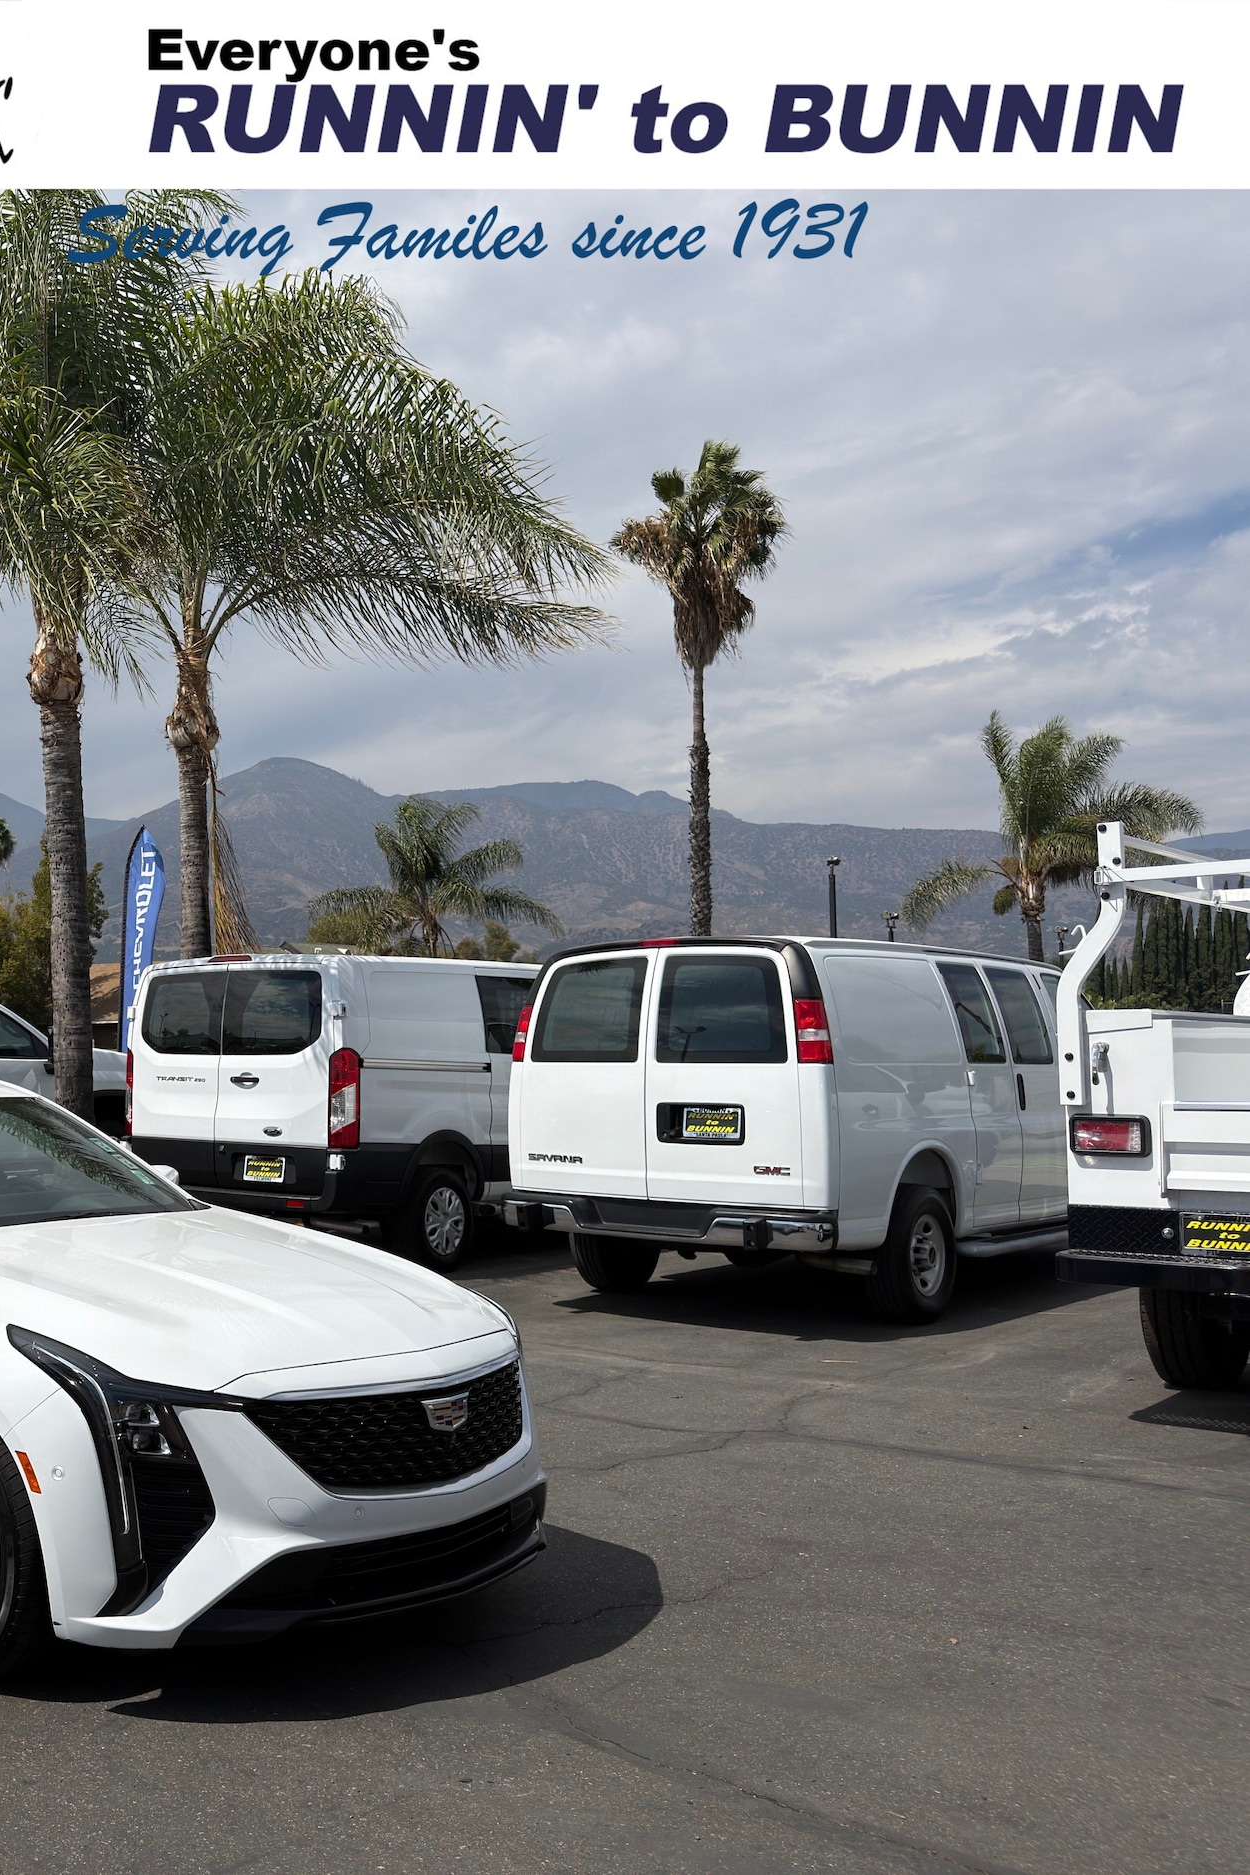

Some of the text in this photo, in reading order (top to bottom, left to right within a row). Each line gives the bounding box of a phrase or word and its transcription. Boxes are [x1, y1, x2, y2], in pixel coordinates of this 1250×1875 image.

[688, 1112, 737, 1120] RUNNIN'
[687, 1125, 735, 1133] BUNNIN
[528, 1153, 583, 1164] SAVANA
[753, 1165, 791, 1176] GMC
[1219, 1231, 1241, 1239] to
